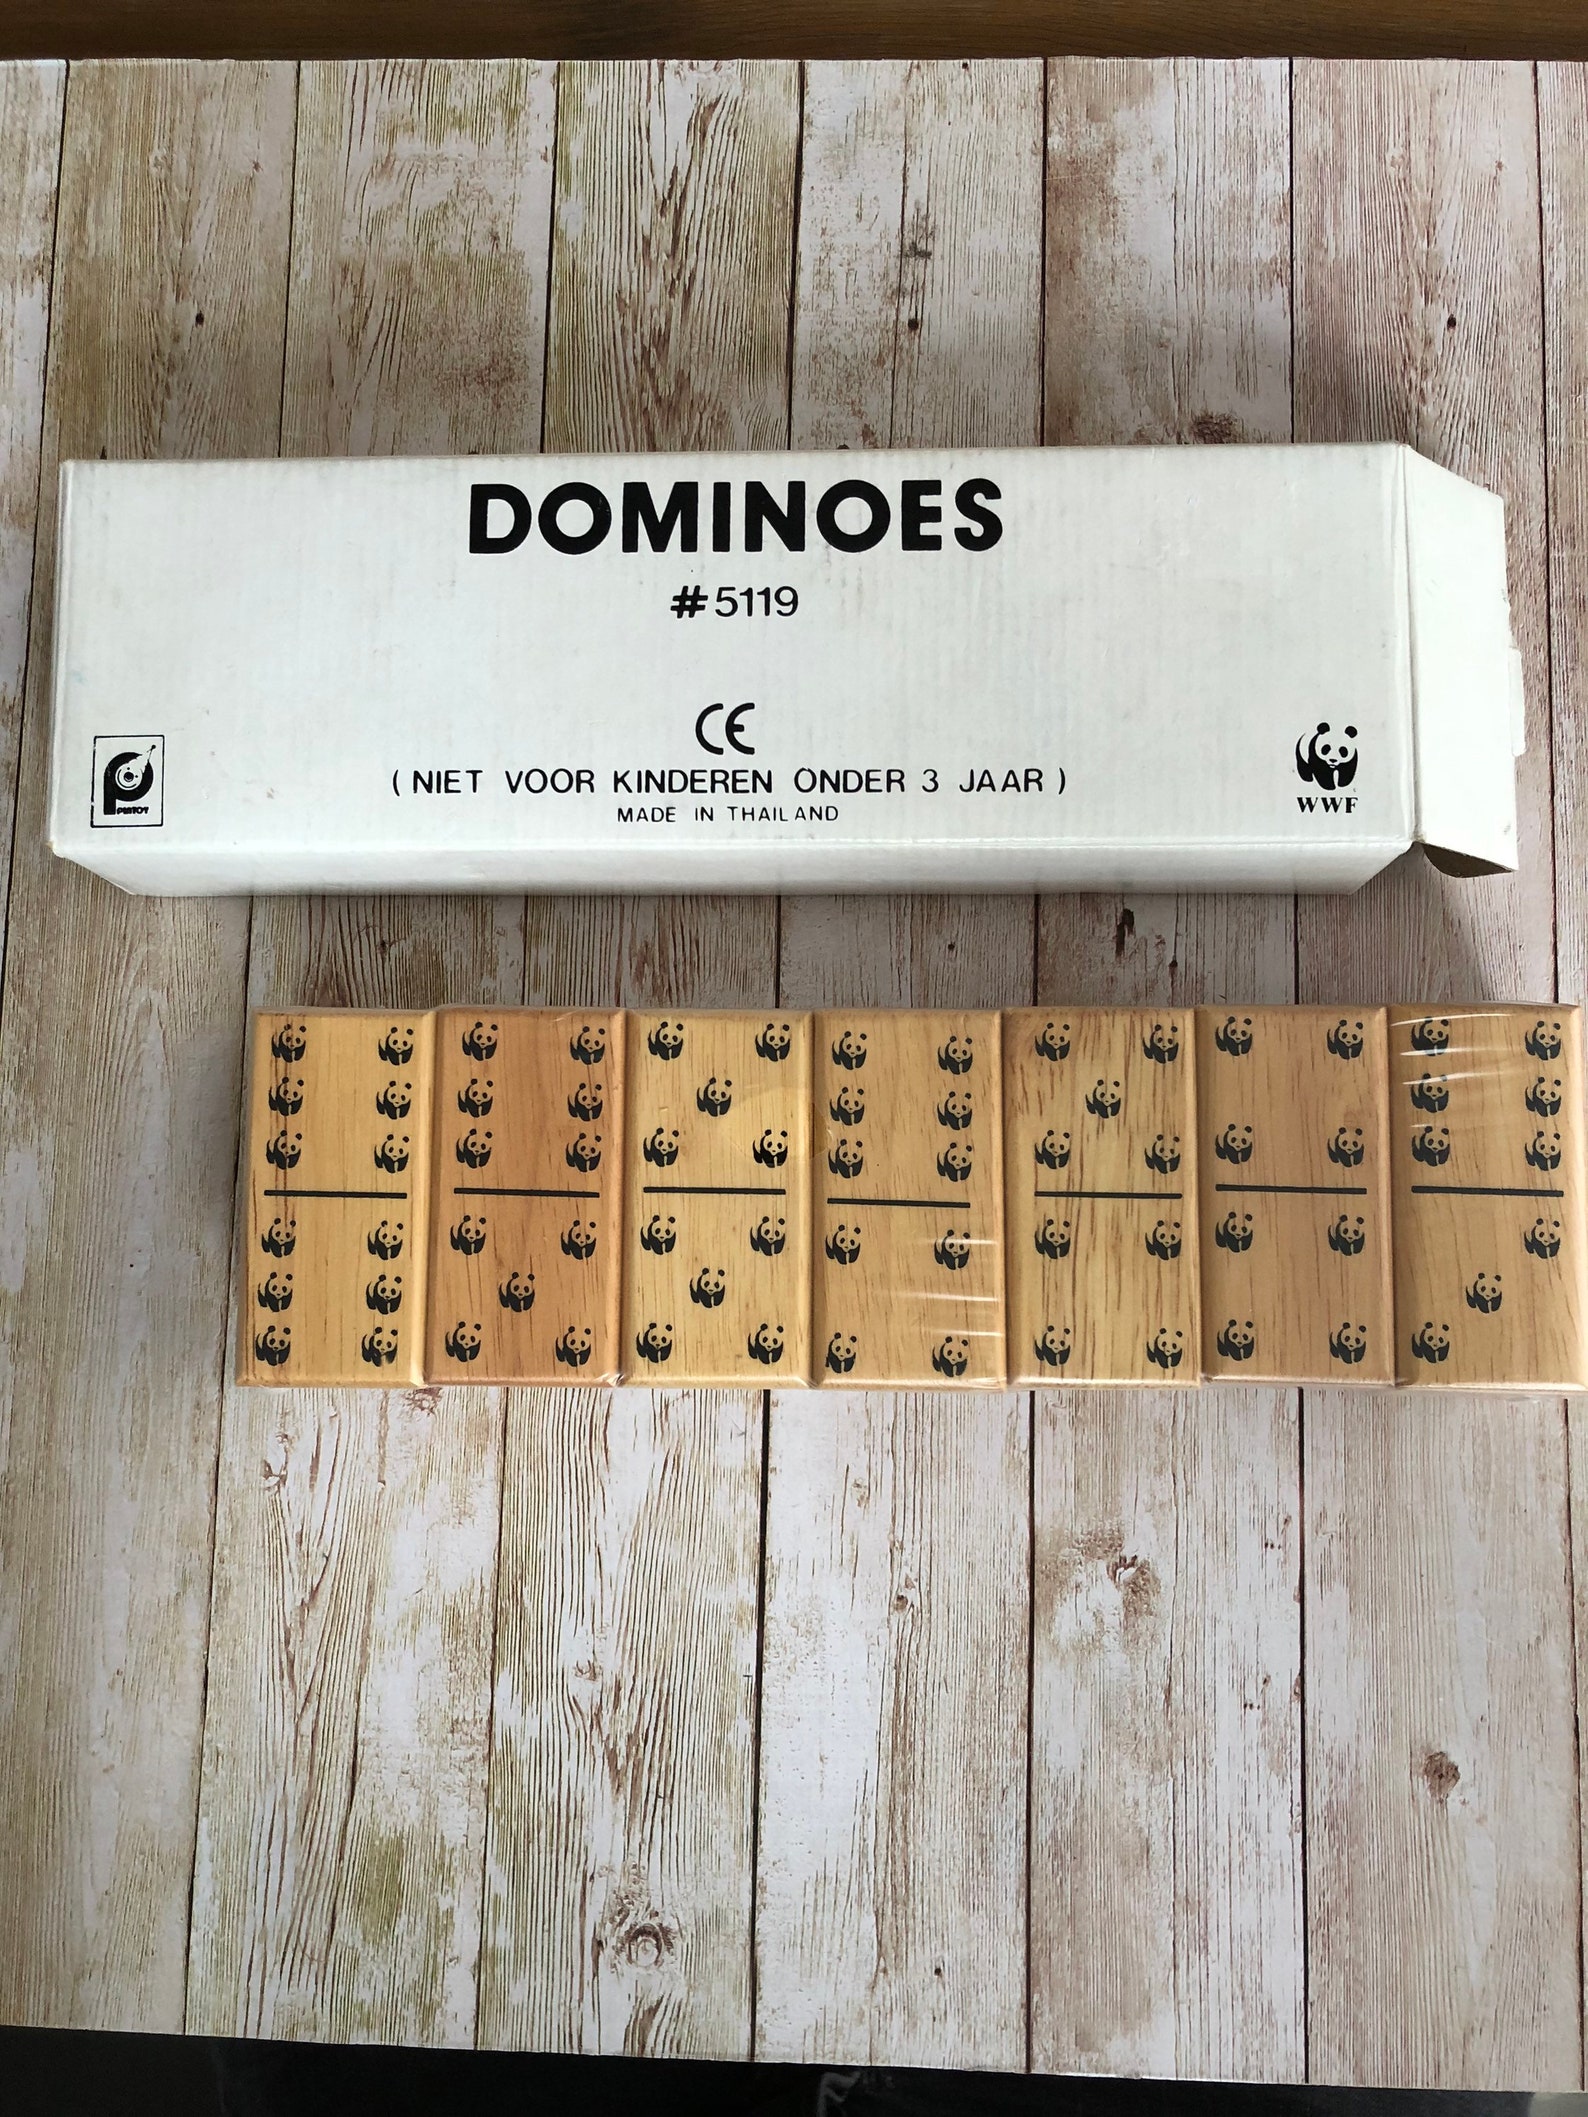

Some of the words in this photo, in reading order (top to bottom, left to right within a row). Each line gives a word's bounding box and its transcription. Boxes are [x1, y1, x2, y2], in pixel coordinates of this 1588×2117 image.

[469, 478, 1003, 555] DOMINOES
[670, 584, 799, 619] #5119
[695, 702, 756, 756] CE
[504, 768, 595, 794] VOOR
[613, 769, 773, 794] KINDEREN
[793, 767, 905, 794] ONDER
[921, 768, 939, 793] 3
[617, 806, 676, 823] MADE
[695, 806, 714, 822] IN
[727, 805, 839, 822] THAILAND
[1296, 796, 1359, 814] WWF
